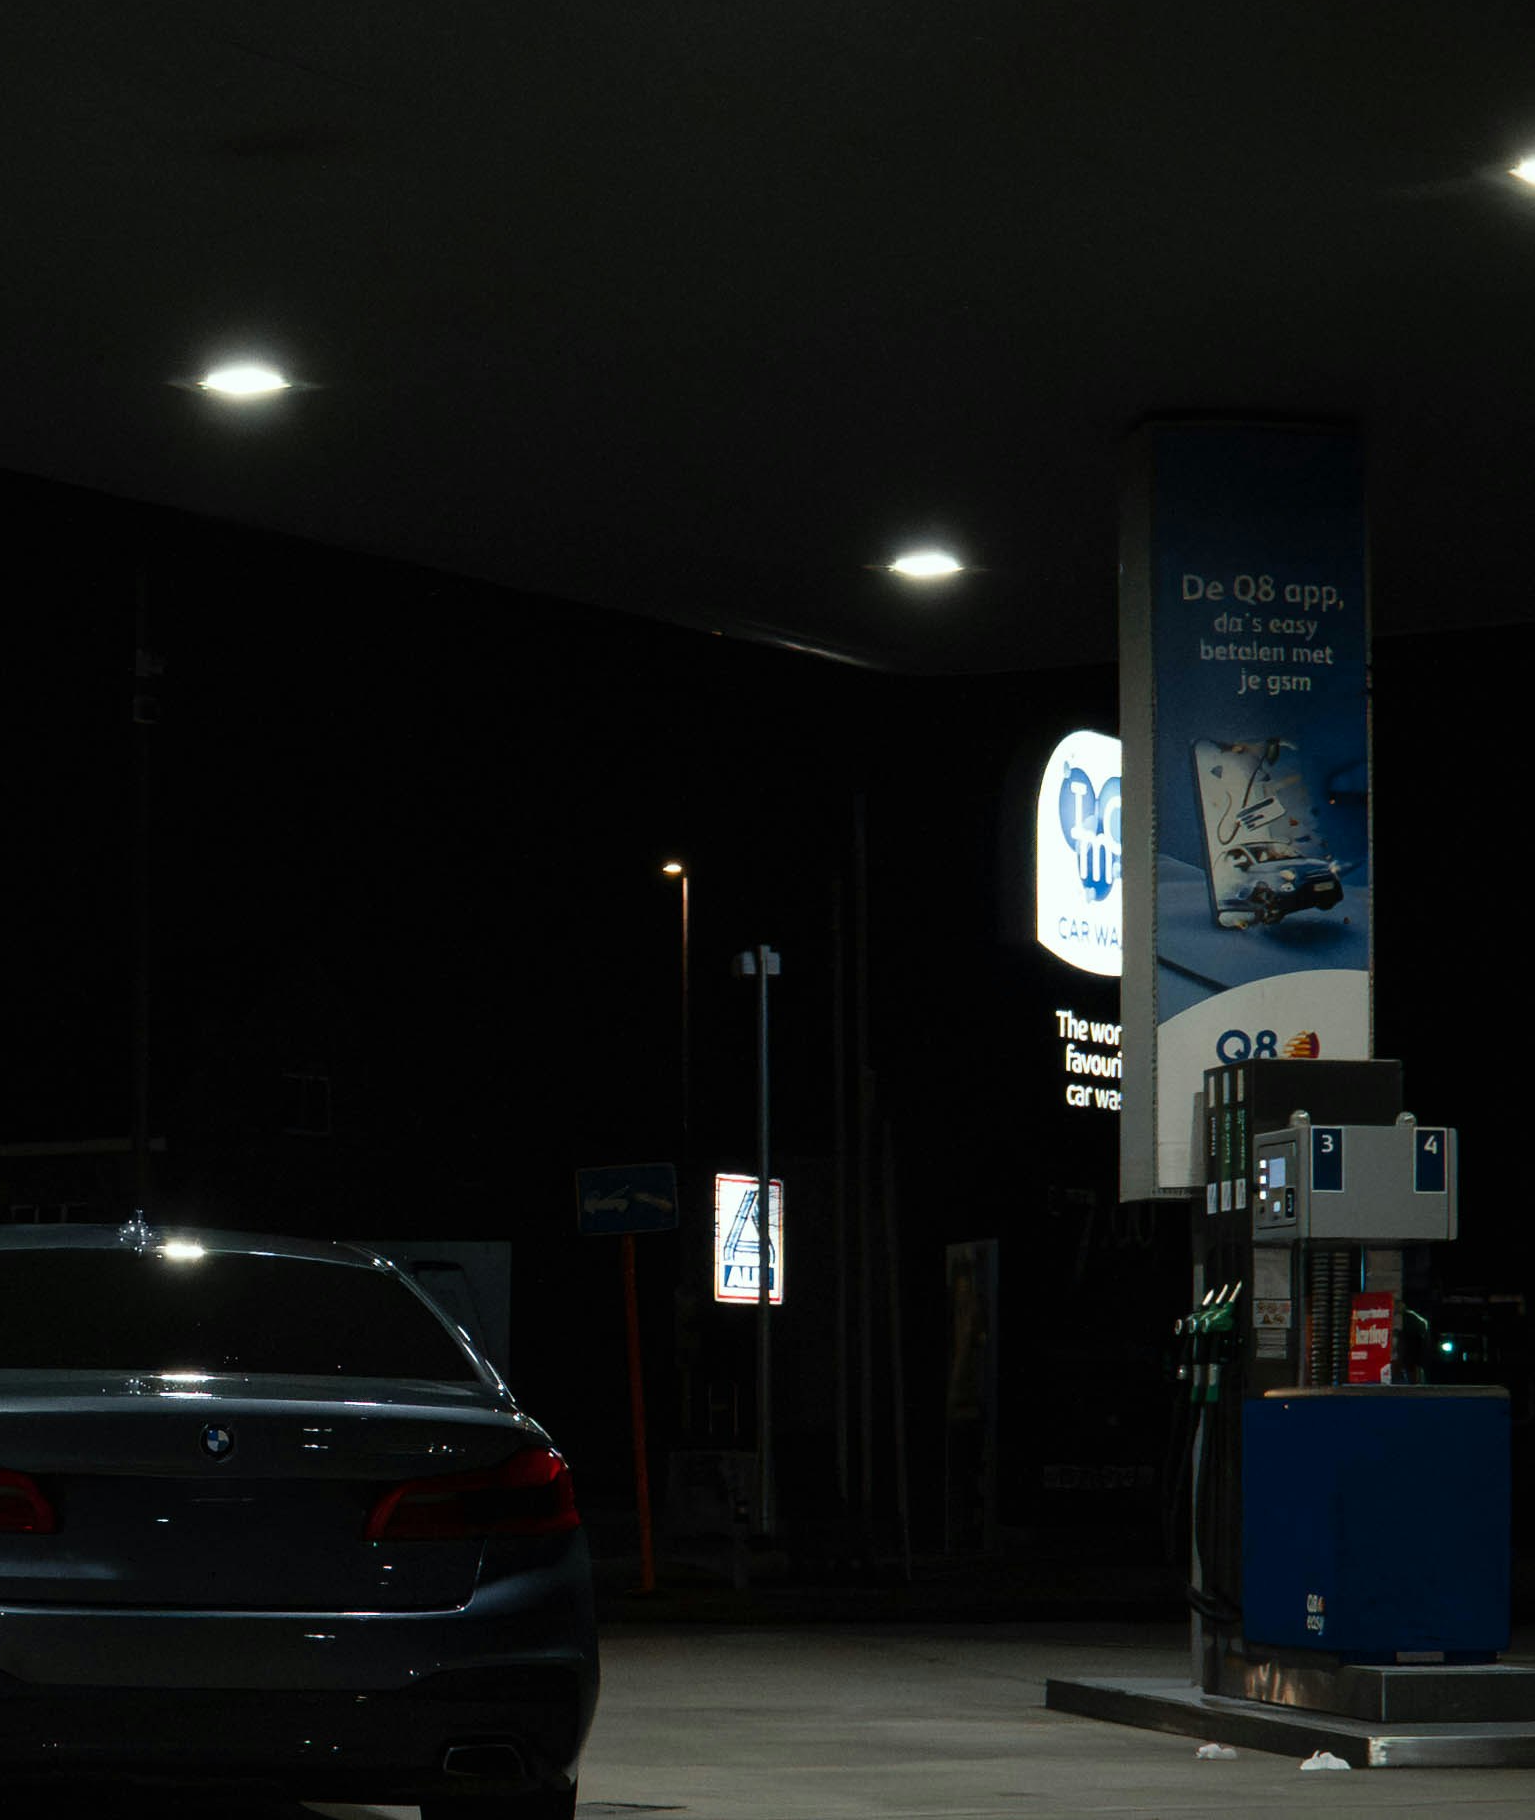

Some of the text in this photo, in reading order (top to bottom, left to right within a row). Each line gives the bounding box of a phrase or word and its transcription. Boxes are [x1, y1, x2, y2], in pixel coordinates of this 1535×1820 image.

[1181, 574, 1345, 611] De Q8 app,
[1214, 611, 1318, 640] da's easy
[1199, 638, 1334, 666] betalen met
[1238, 669, 1311, 696] je gsm
[1059, 916, 1122, 951] CAR WA
[1055, 1010, 1089, 1042] The
[1217, 1030, 1278, 1065] Q8
[1066, 1084, 1093, 1107] car
[1320, 1134, 1335, 1154] 3
[1423, 1135, 1438, 1155] 4
